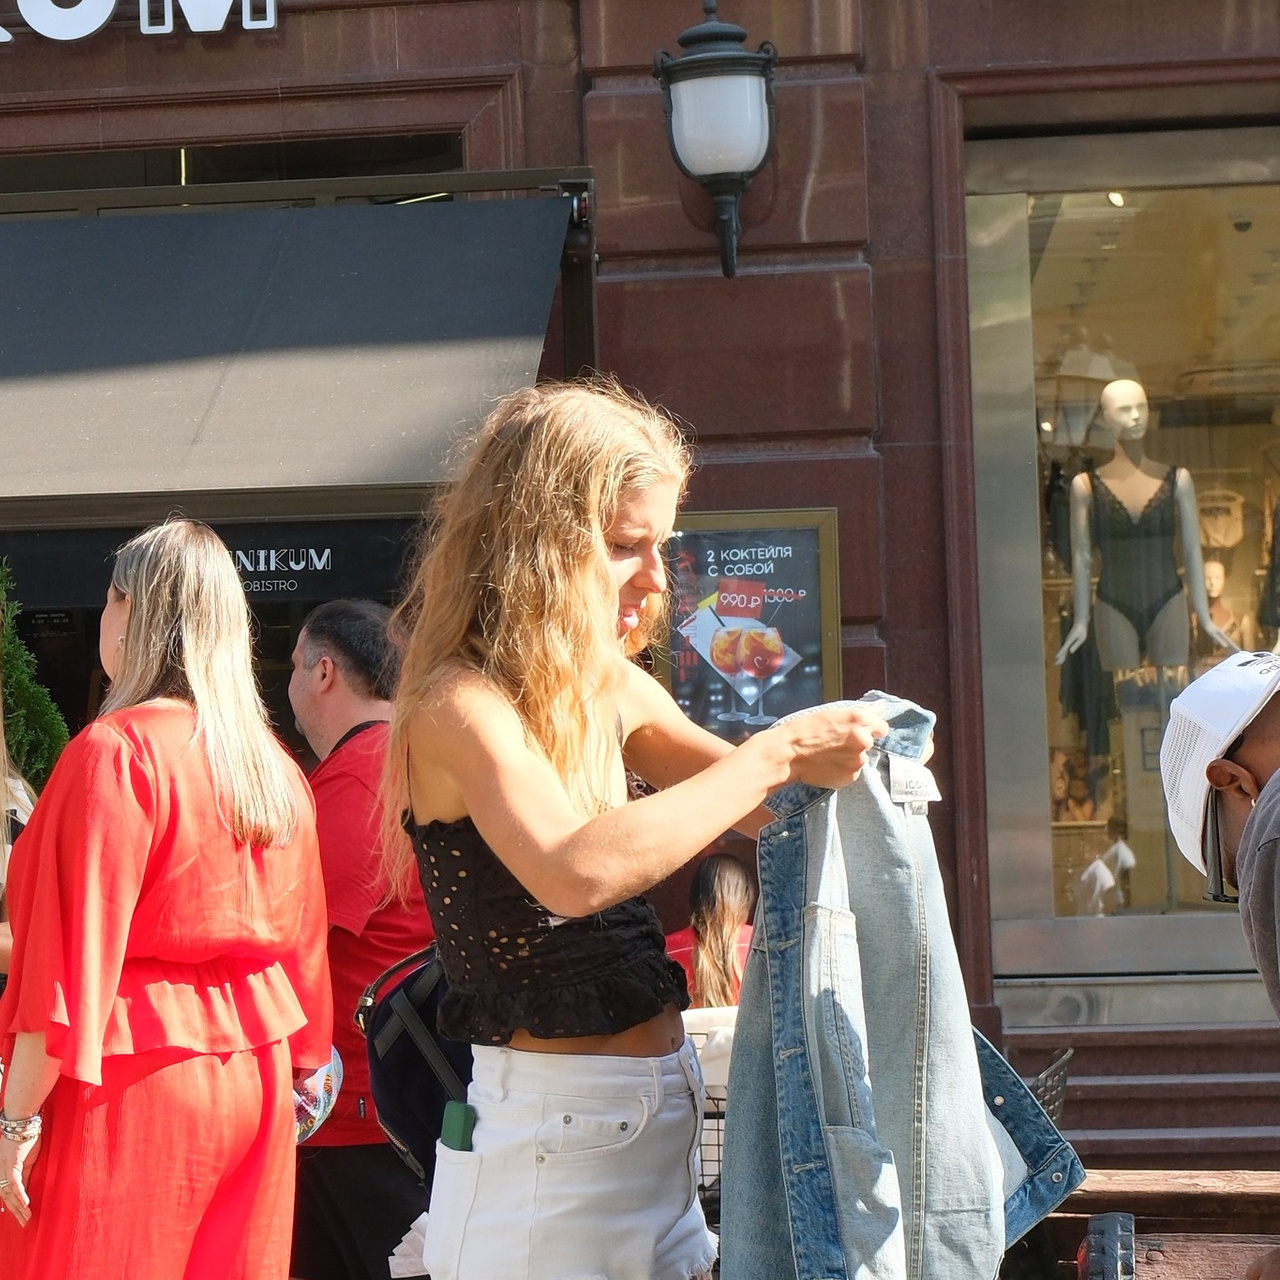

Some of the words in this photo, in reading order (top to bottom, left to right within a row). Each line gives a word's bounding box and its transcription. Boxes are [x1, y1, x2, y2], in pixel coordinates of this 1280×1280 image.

[229, 548, 332, 572] NIKUM
[707, 550, 715, 562] 2
[721, 545, 793, 561] КОКТЕЙЛЯ
[708, 566, 719, 577] С
[724, 560, 774, 576] СОБОЙ
[242, 579, 298, 593] OBISTRO
